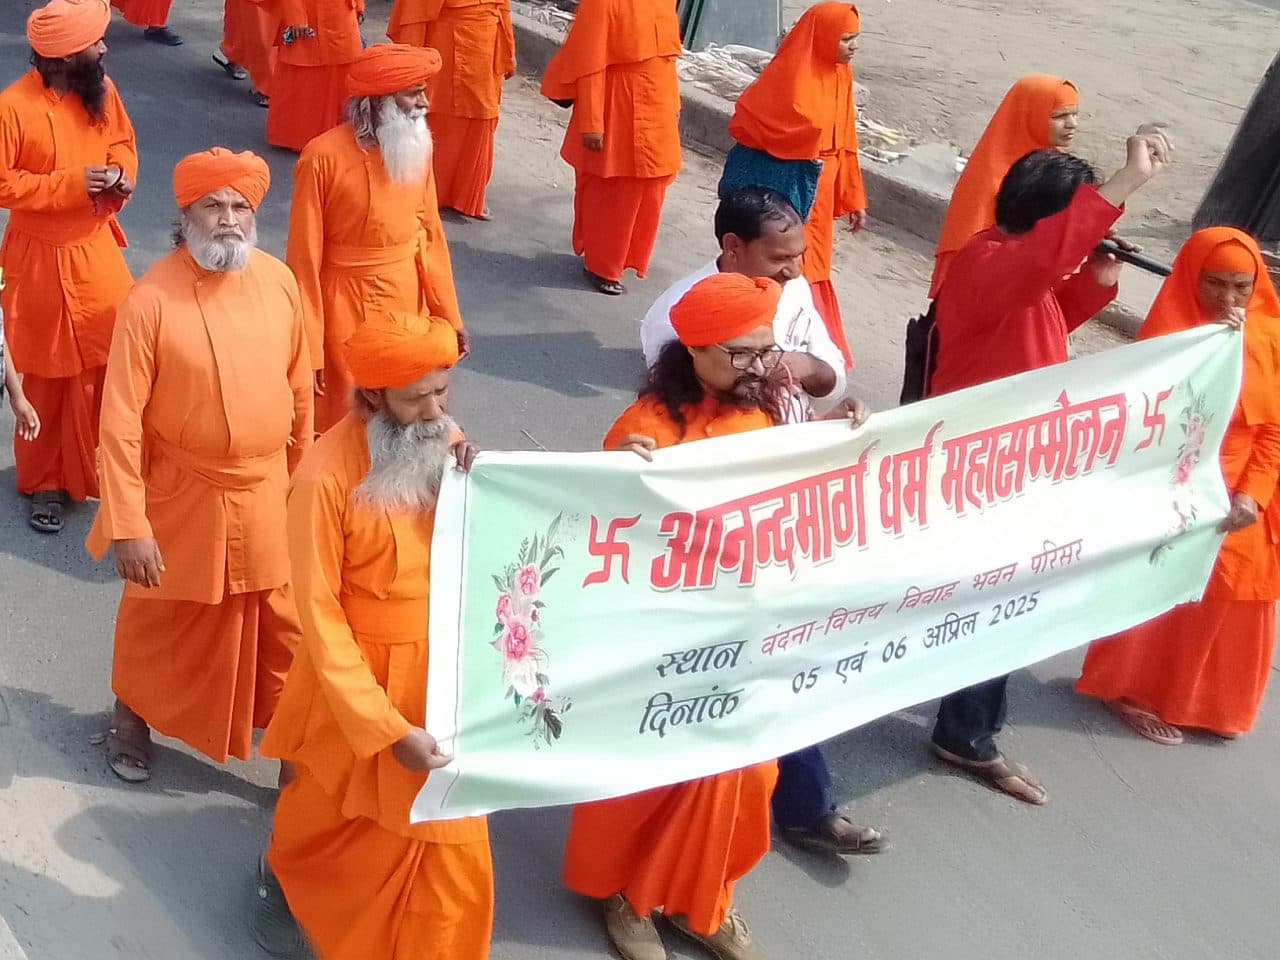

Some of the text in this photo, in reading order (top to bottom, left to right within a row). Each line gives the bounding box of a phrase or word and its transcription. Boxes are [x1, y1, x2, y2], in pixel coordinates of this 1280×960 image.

[649, 390, 1127, 589] आनन्दमार्ग धर्म महासम्मेलन
[638, 590, 1041, 738] दिनांक 05 एवं 06 अप्रिल 2025
[656, 639, 749, 678] स्थान
[896, 580, 961, 614] विवाह
[972, 561, 1019, 591] भवन
[1030, 539, 1084, 574] परिसर
